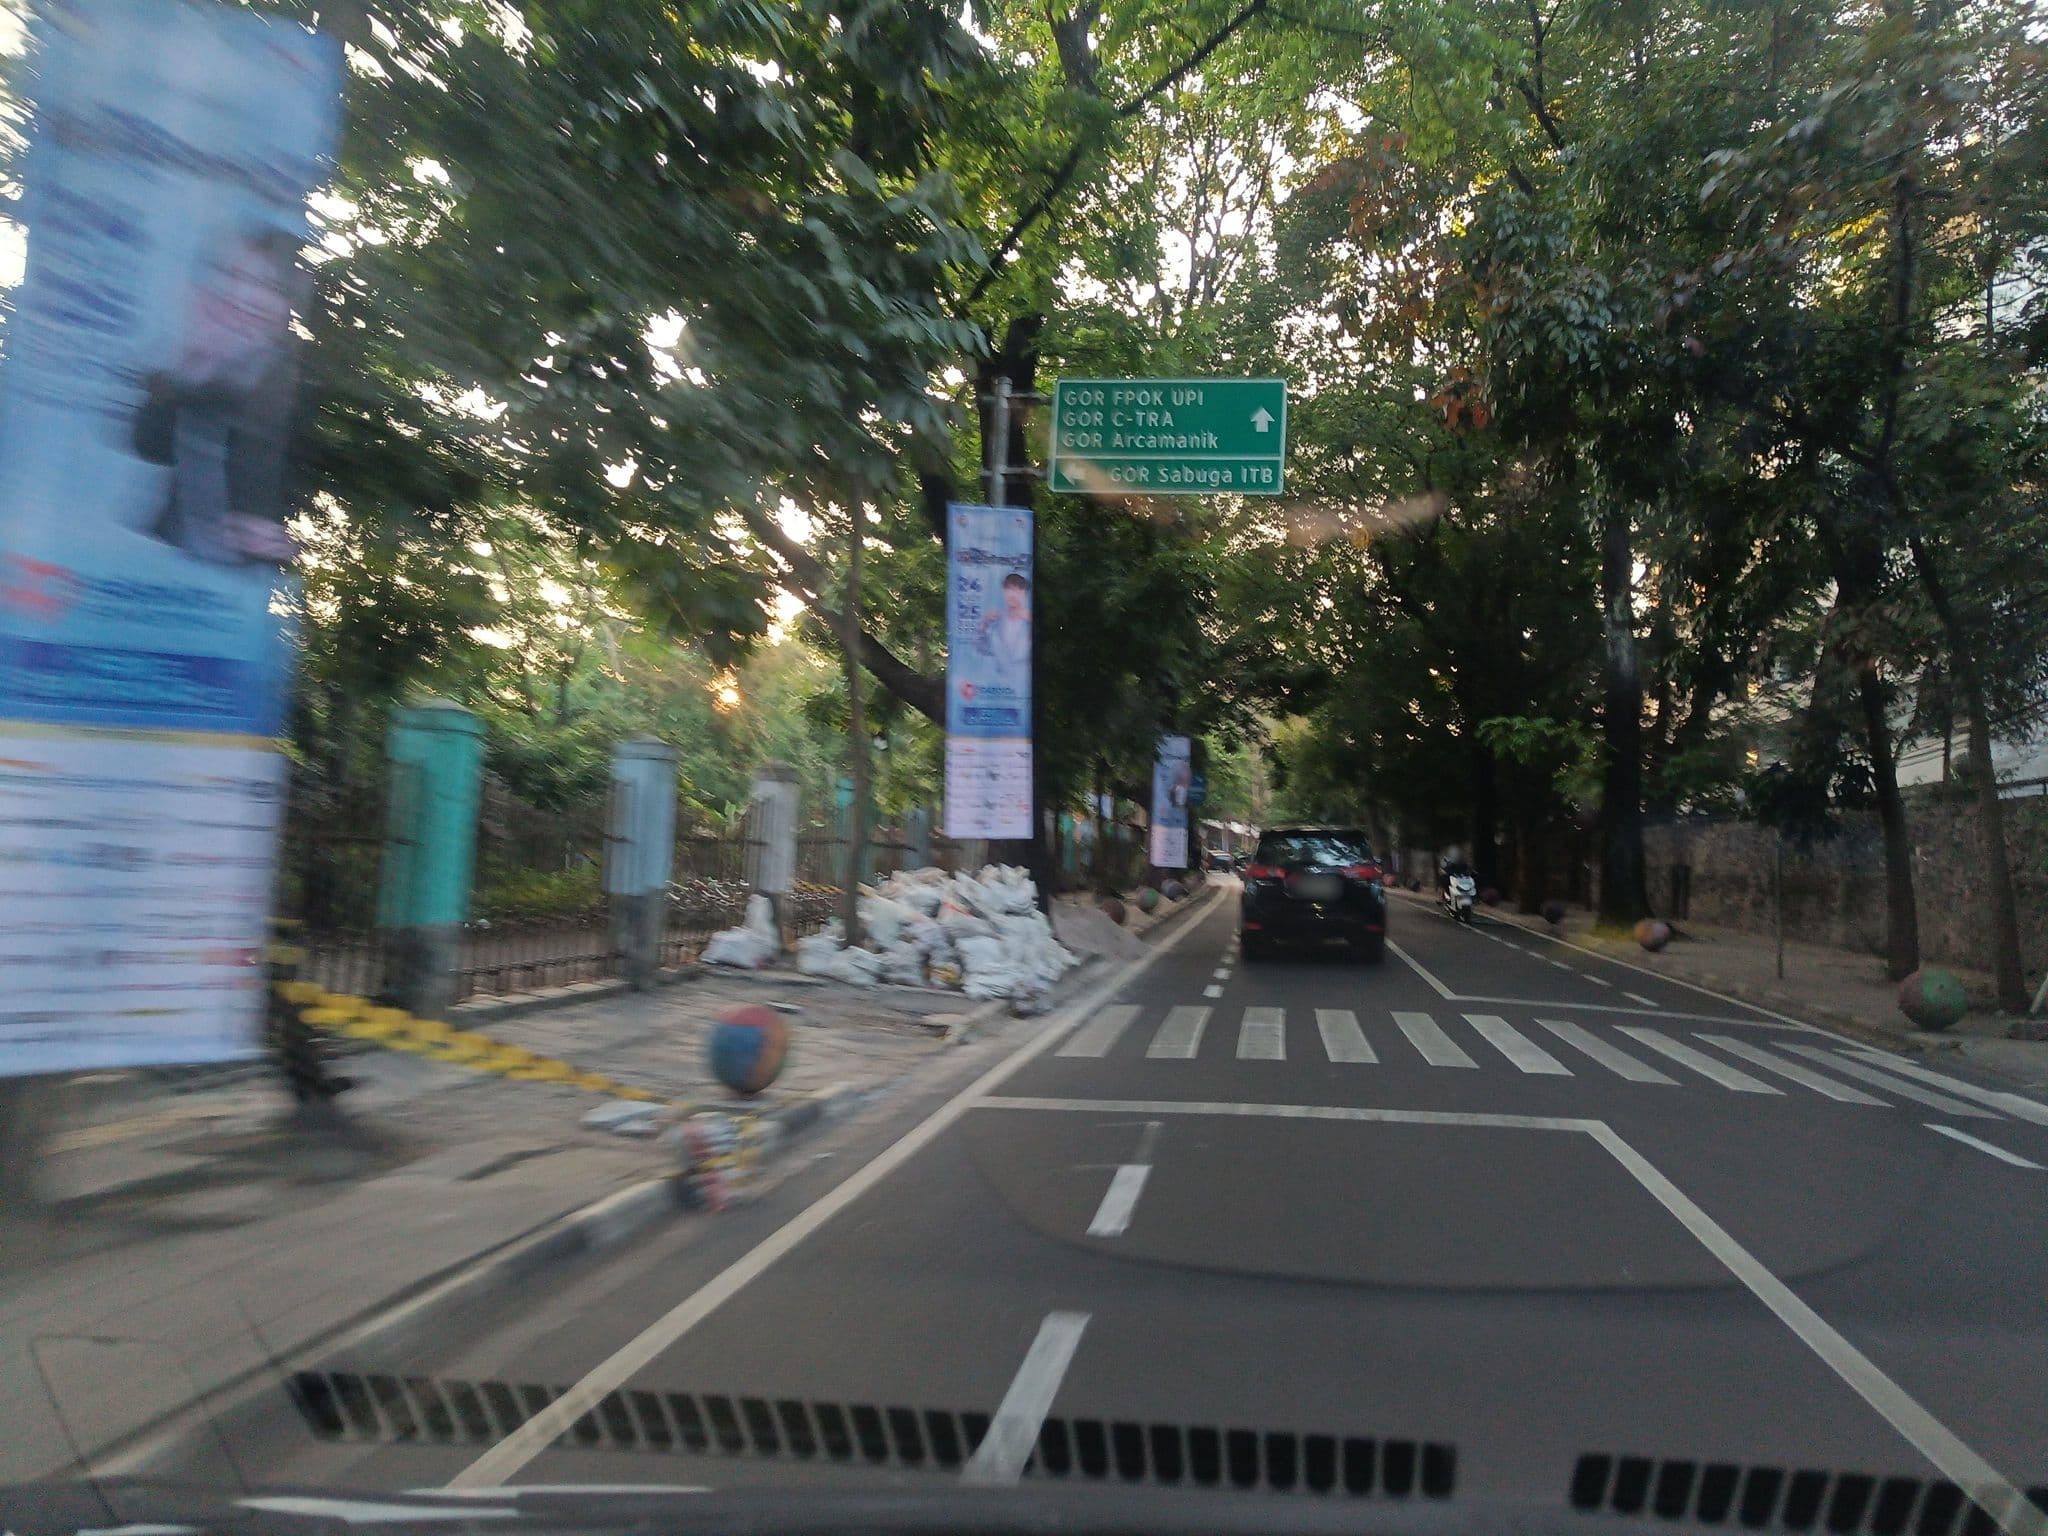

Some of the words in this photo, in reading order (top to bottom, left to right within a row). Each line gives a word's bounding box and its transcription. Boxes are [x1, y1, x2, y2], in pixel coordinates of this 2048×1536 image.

[1063, 390, 1104, 406] GOR
[1113, 390, 1164, 407] FPOK
[1172, 390, 1205, 407] UPI
[1063, 411, 1104, 427] GOR
[1112, 411, 1175, 428] C-TRA
[1062, 432, 1103, 449] GOR
[1112, 432, 1219, 449] Arcamanik
[1111, 466, 1151, 483] GOR
[1158, 465, 1233, 487] Sabuga
[1241, 466, 1274, 483] ITB
